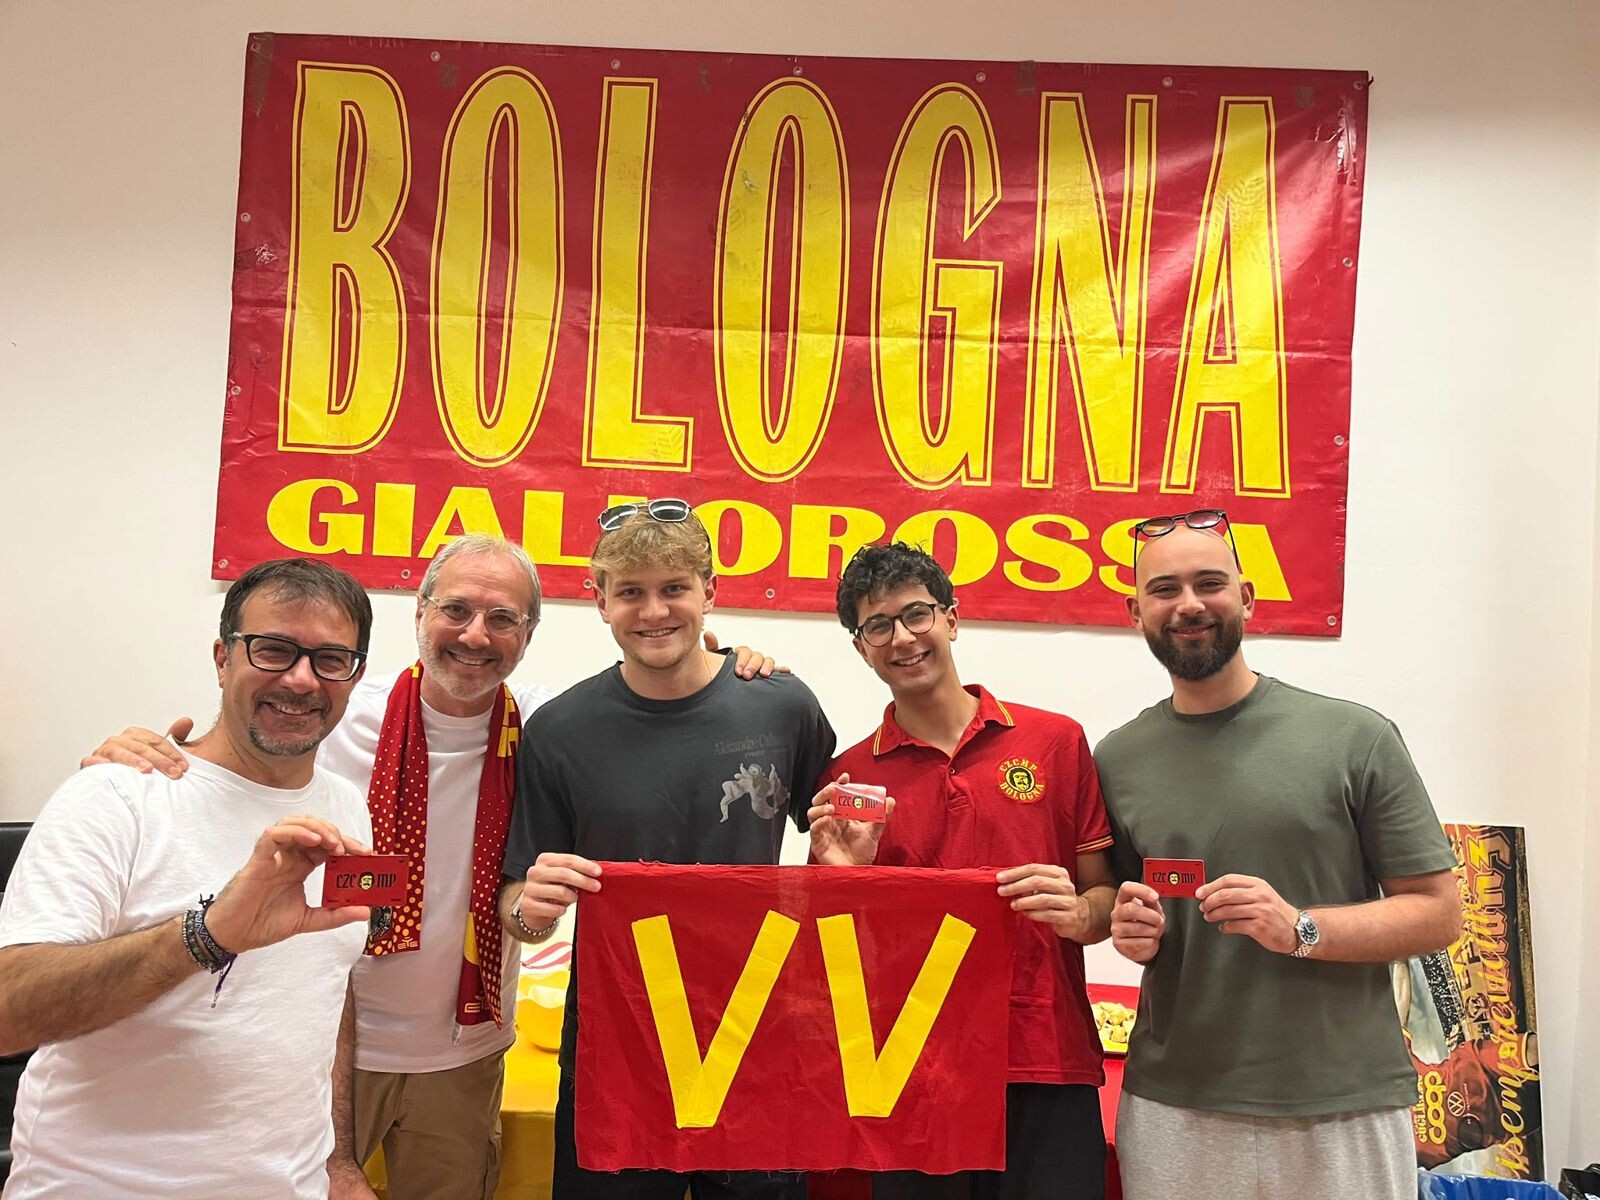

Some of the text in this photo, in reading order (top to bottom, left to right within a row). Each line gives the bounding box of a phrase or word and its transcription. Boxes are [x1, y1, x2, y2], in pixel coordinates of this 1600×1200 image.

[277, 60, 1291, 498] BOLOGNA
[266, 478, 1293, 602] GIALOROSSA
[1000, 782, 1044, 800] BOLOGNA
